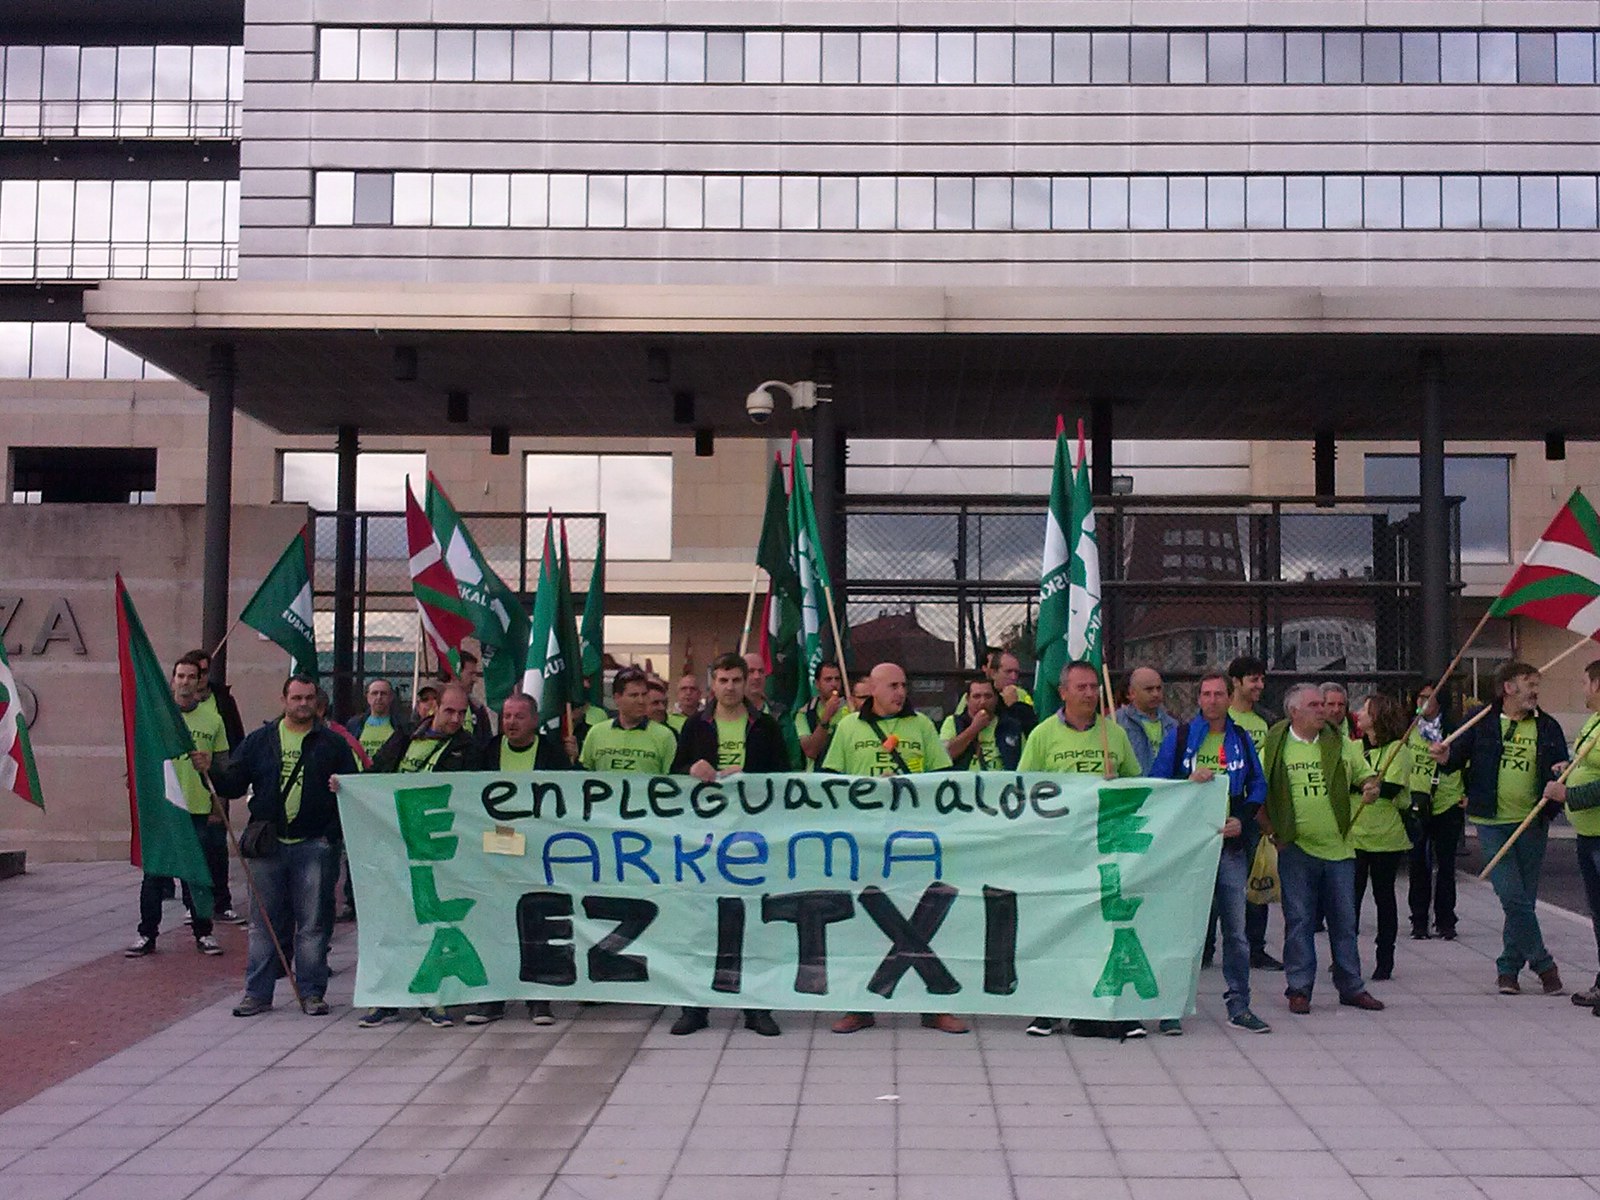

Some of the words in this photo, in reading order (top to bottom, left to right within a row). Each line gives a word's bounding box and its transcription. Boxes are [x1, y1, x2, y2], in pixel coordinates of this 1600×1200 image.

[610, 758, 636, 770] EZ
[1076, 761, 1103, 773] EZ
[516, 891, 660, 986] EZ
[711, 881, 1019, 999] ITXI
